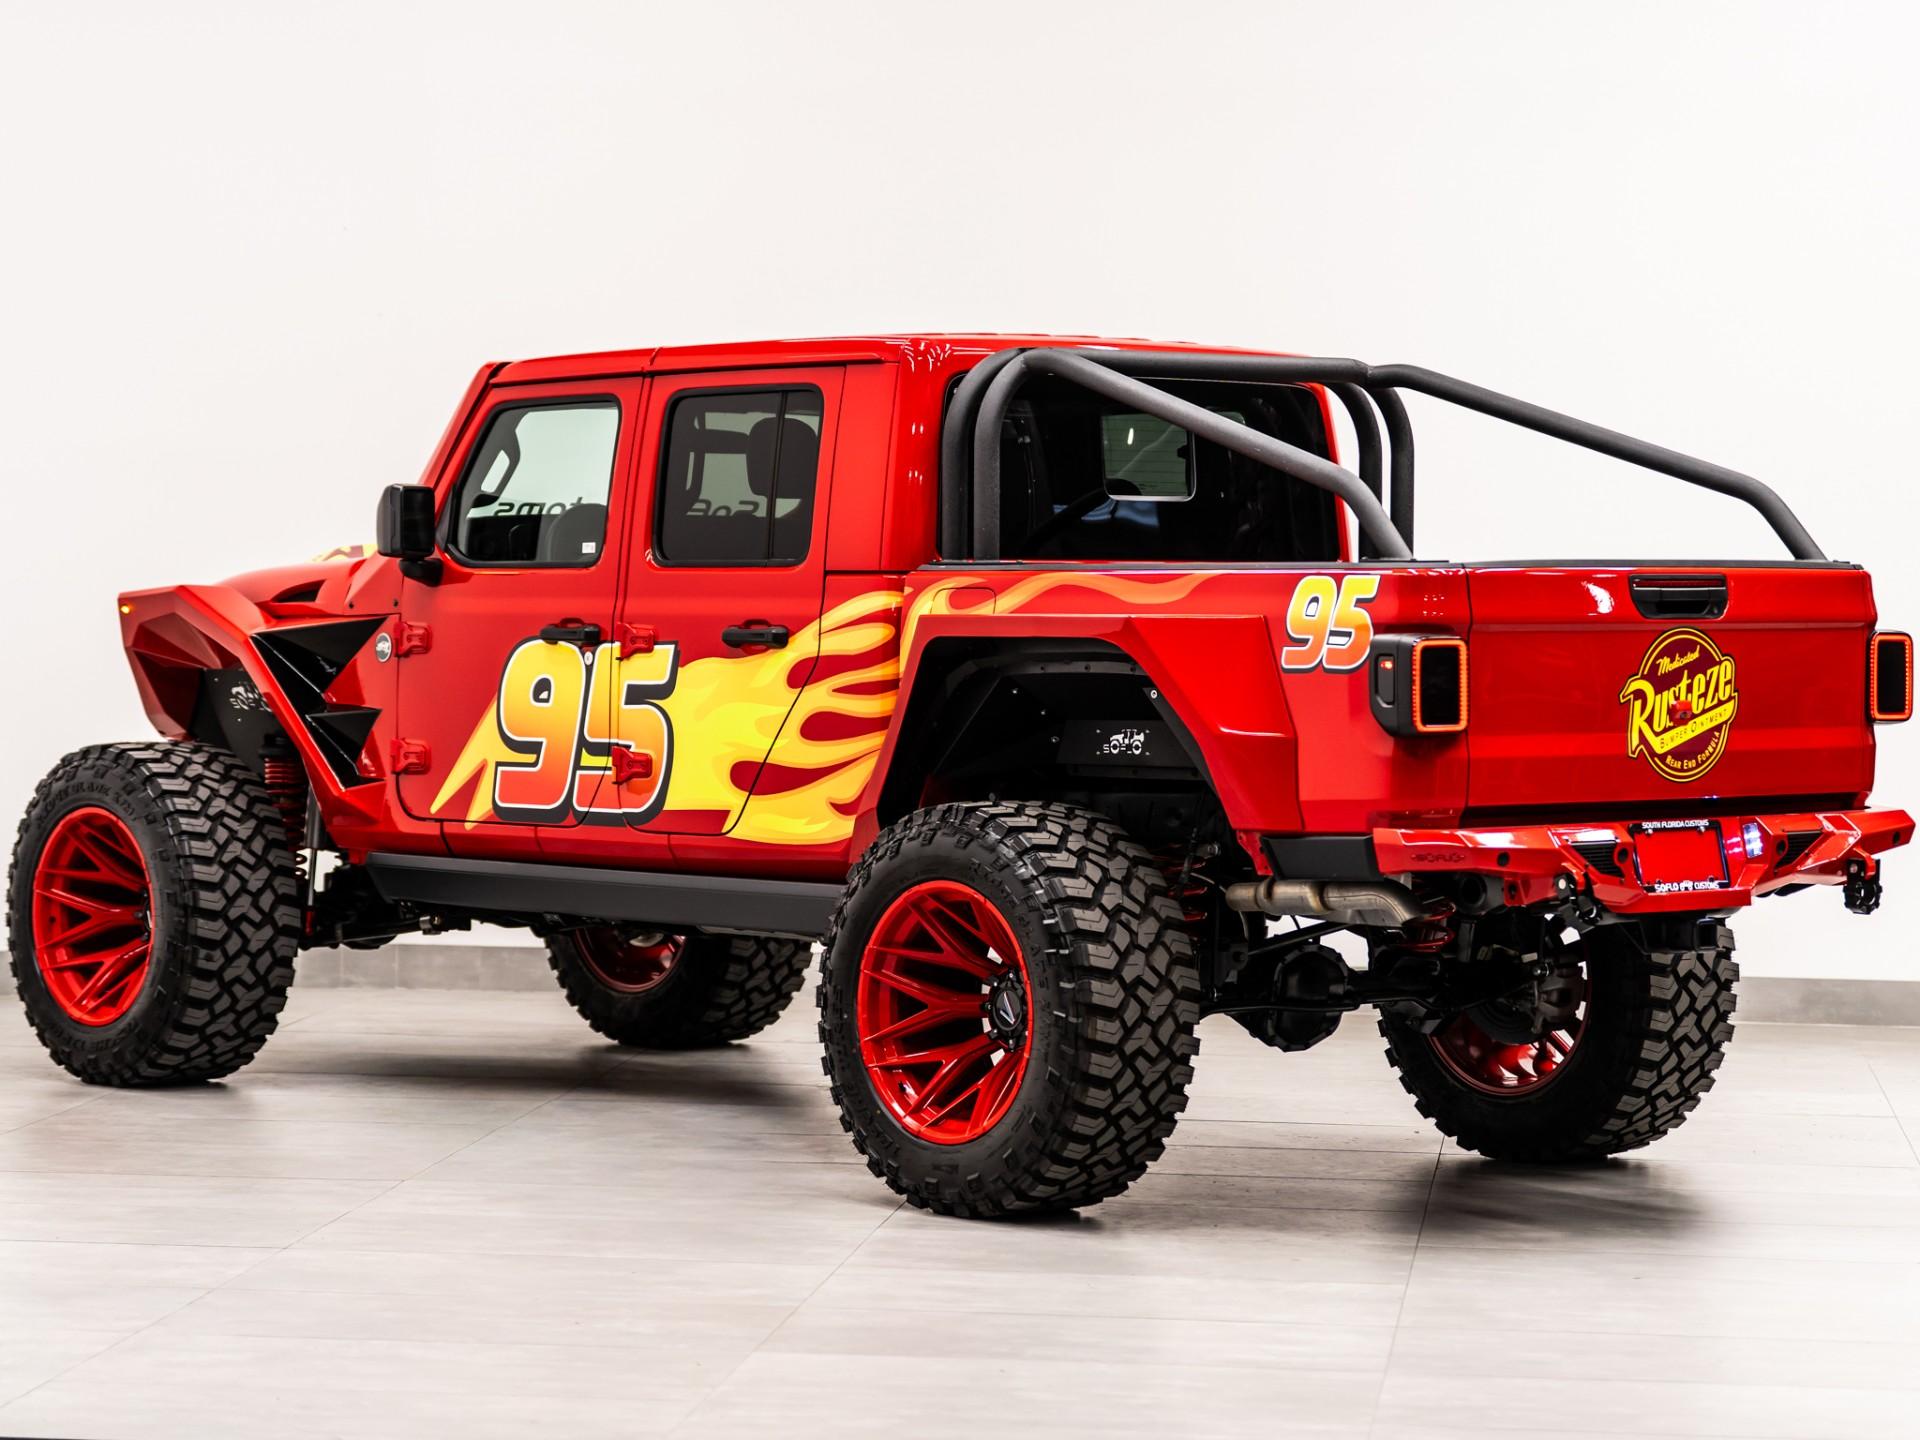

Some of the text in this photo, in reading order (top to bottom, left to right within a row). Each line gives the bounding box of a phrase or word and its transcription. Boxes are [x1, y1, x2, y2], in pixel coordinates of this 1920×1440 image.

[1281, 575, 1381, 674] 95
[1656, 645, 1700, 676] Medicated
[493, 637, 679, 825] 95
[1683, 759, 1697, 769] END
[1641, 819, 1710, 829] SOUTH FLORIDA CUSTOMS
[1694, 881, 1720, 889] CUSTOMS
